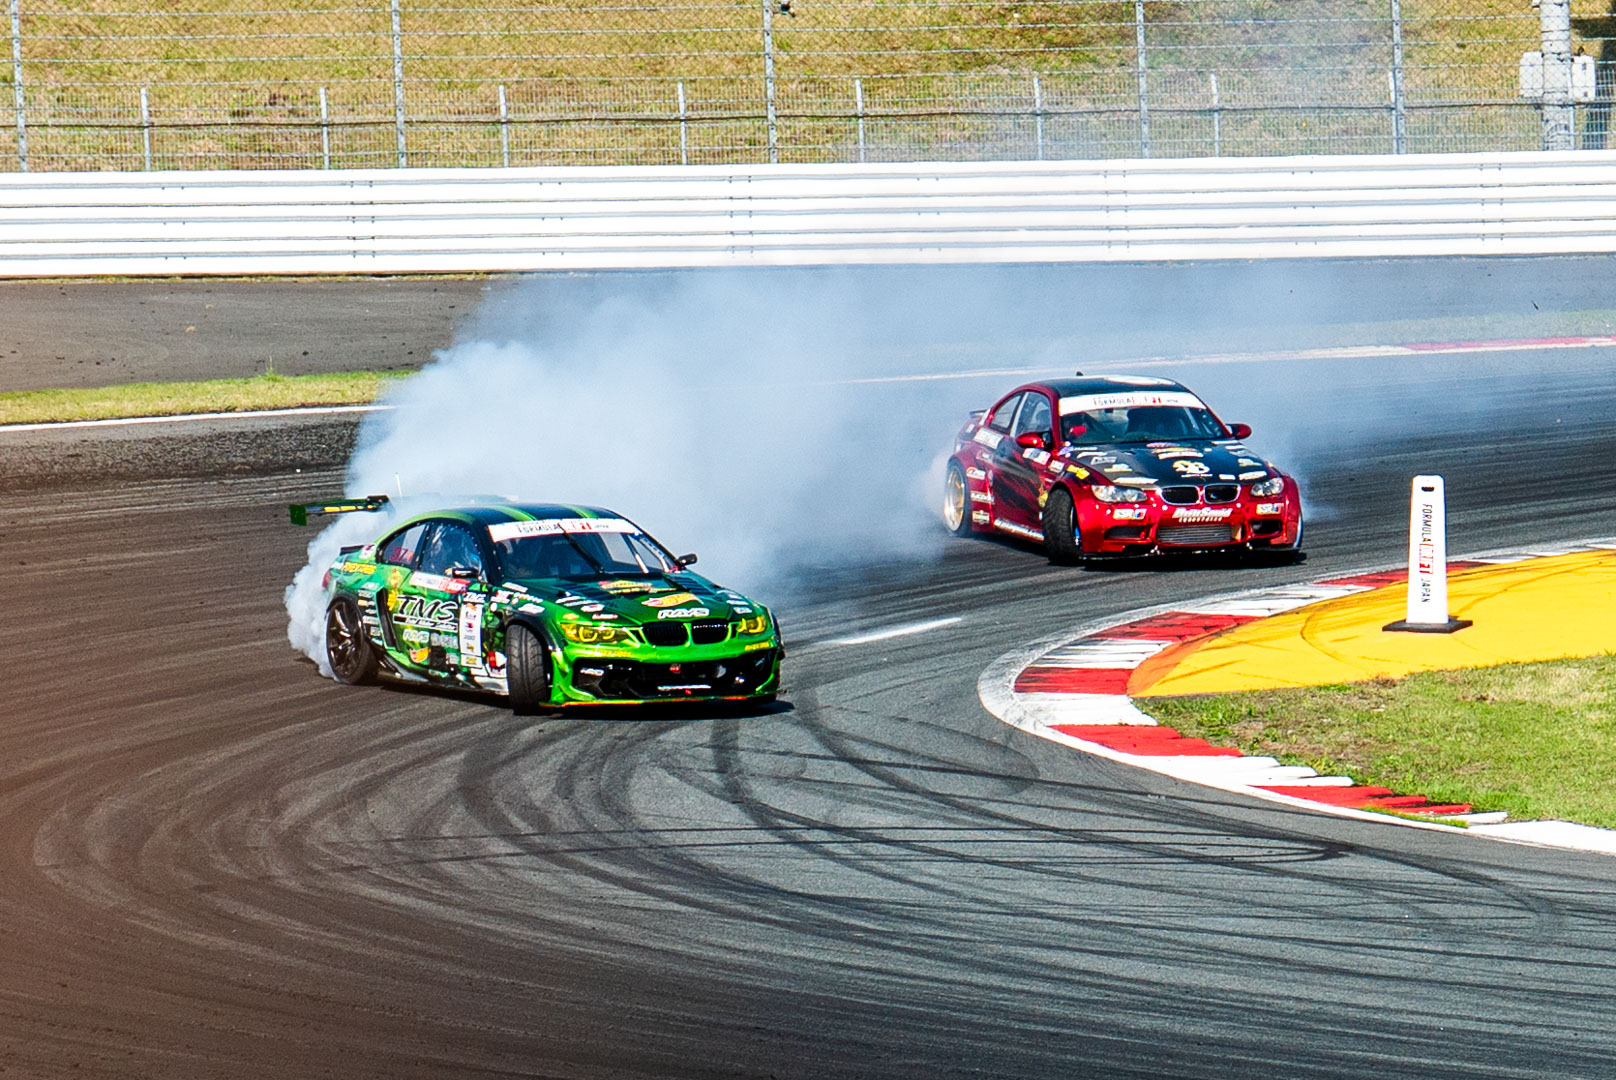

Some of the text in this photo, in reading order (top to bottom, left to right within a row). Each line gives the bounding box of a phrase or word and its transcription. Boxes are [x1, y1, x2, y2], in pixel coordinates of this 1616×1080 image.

[516, 522, 559, 534] FORMULA
[1422, 503, 1433, 543] FORMULA
[1420, 578, 1431, 603] JAPAN
[396, 594, 459, 622] TMS
[658, 607, 710, 620] RAYS
